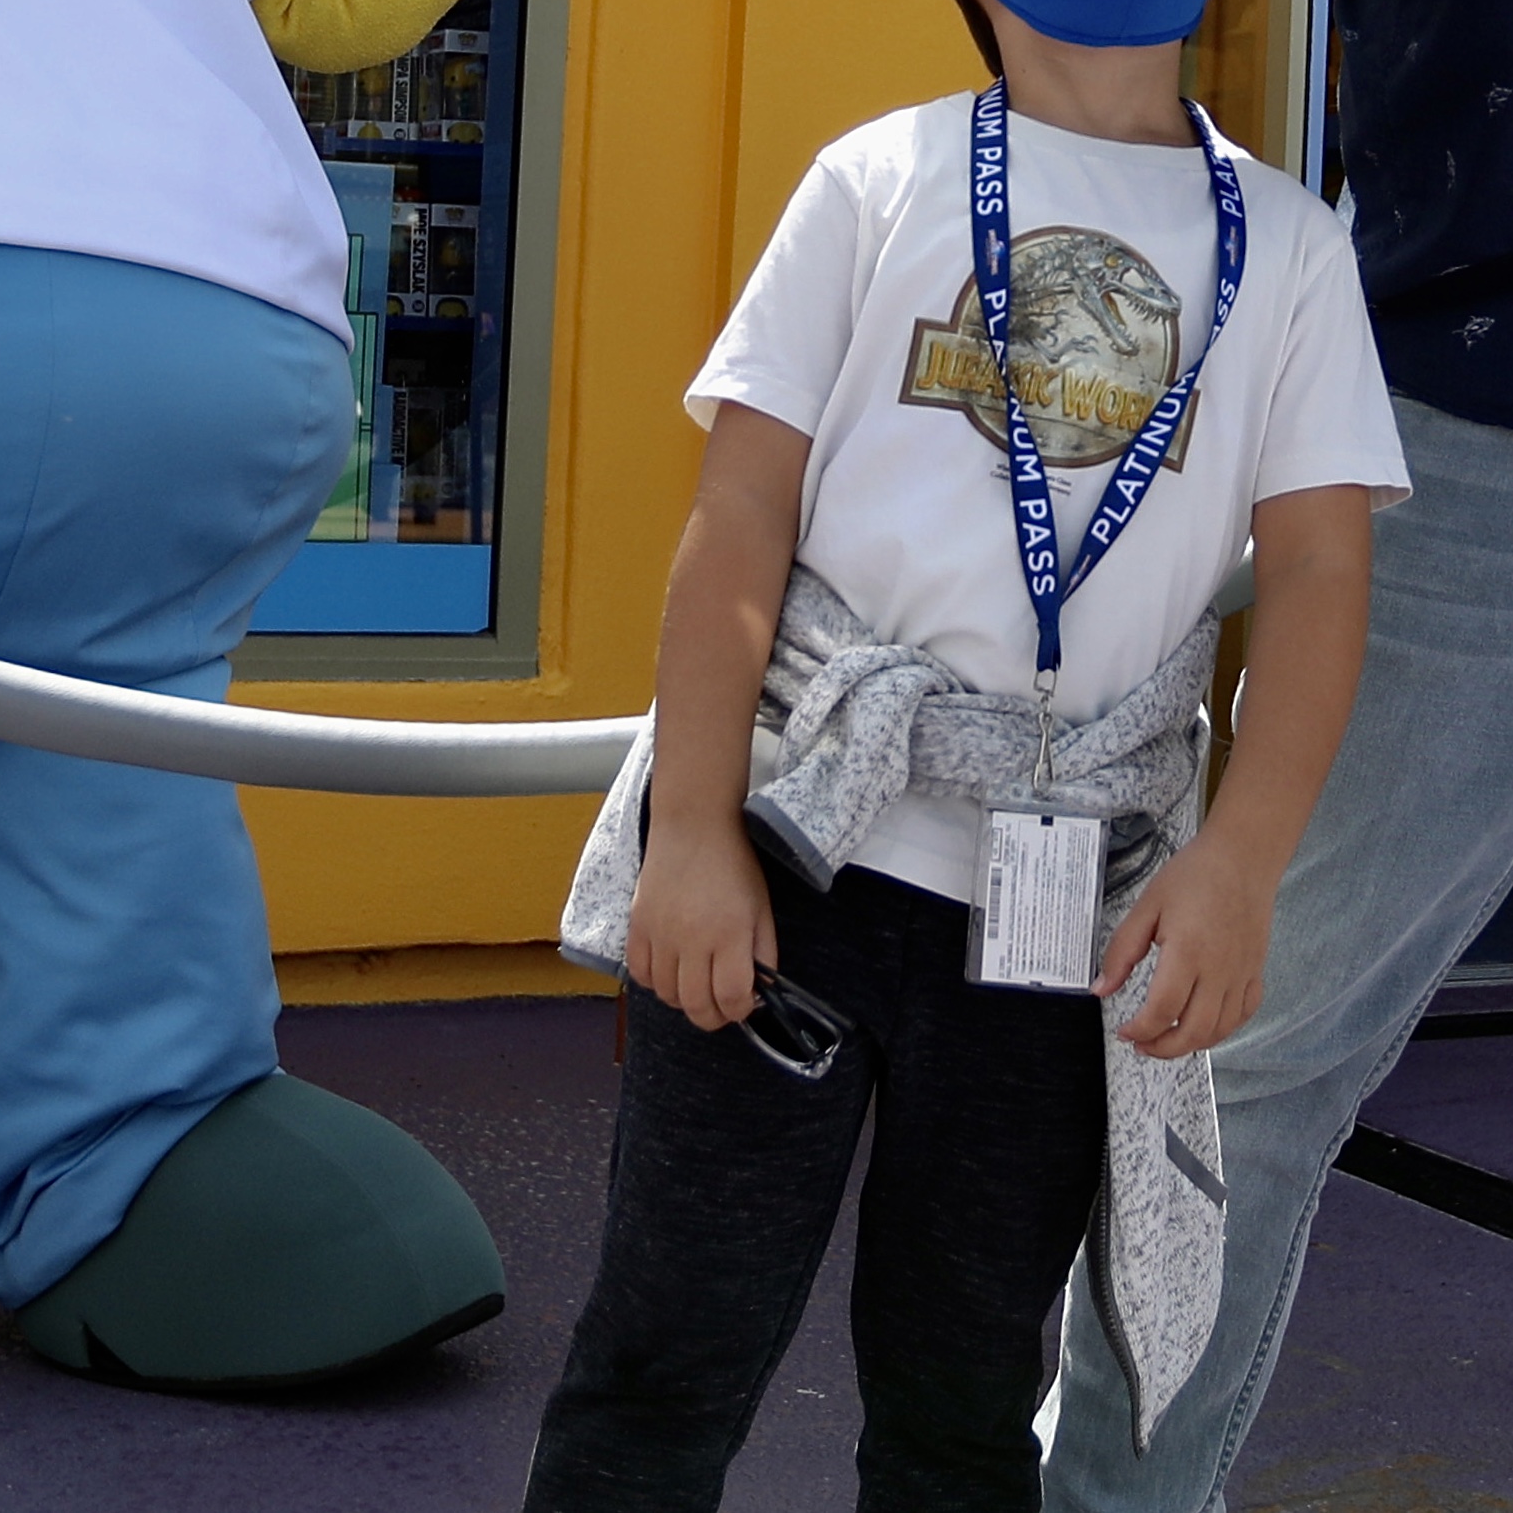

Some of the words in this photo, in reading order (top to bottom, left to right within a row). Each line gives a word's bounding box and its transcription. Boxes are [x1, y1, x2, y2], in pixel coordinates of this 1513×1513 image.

[976, 76, 1003, 138] NUM
[976, 146, 1004, 216] PASS
[412, 239, 427, 294] SZYSLAK
[916, 339, 1061, 408] JURASIC
[1090, 371, 1195, 545] PLATINUM
[1208, 277, 1236, 347] ASS
[1019, 497, 1056, 596] PASS
